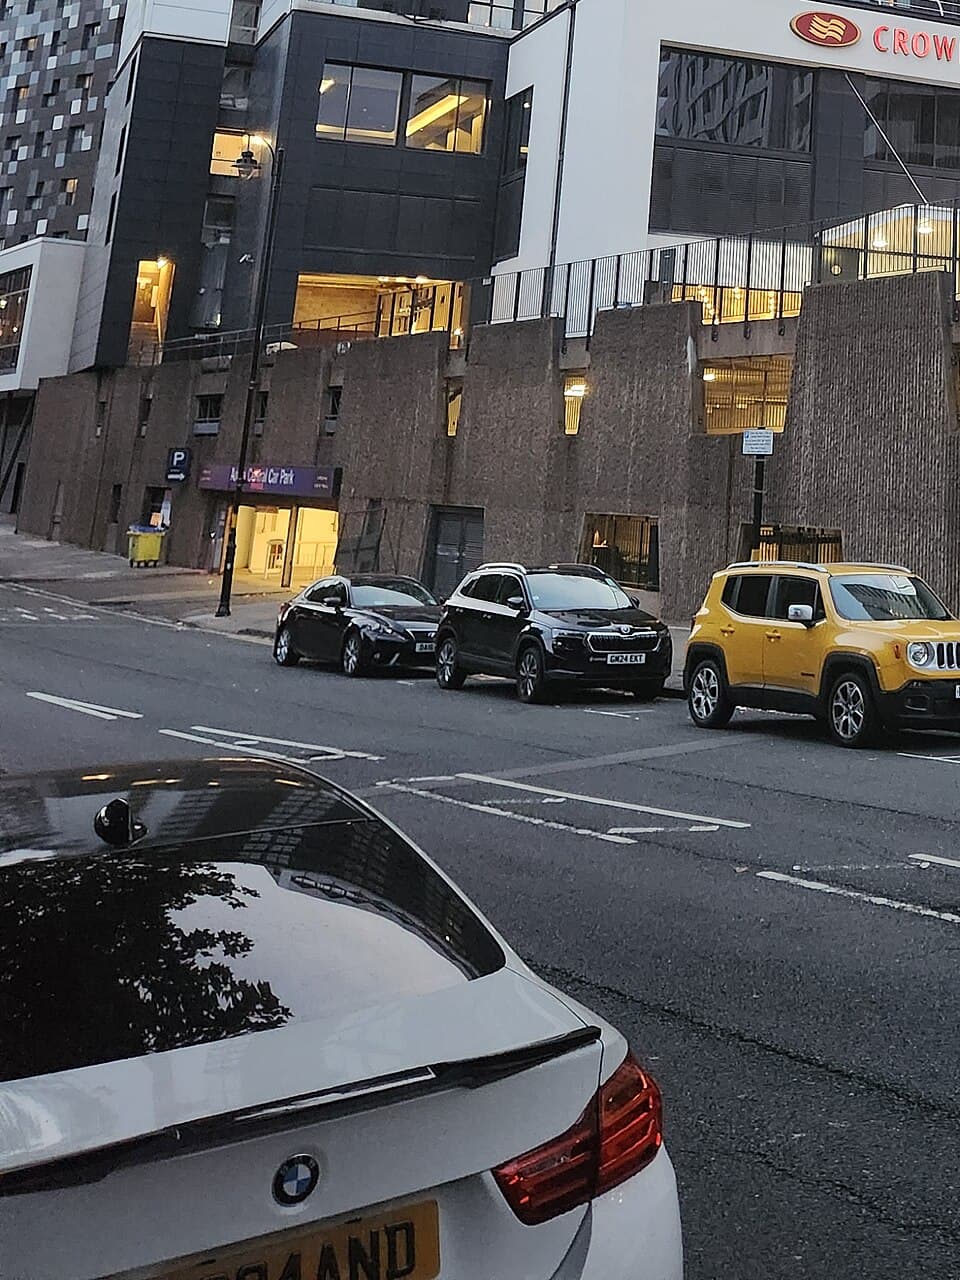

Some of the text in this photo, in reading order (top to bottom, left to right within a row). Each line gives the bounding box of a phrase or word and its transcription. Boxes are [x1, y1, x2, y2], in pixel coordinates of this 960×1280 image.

[173, 451, 185, 466] P
[268, 468, 280, 484] Car
[280, 468, 295, 485] Park
